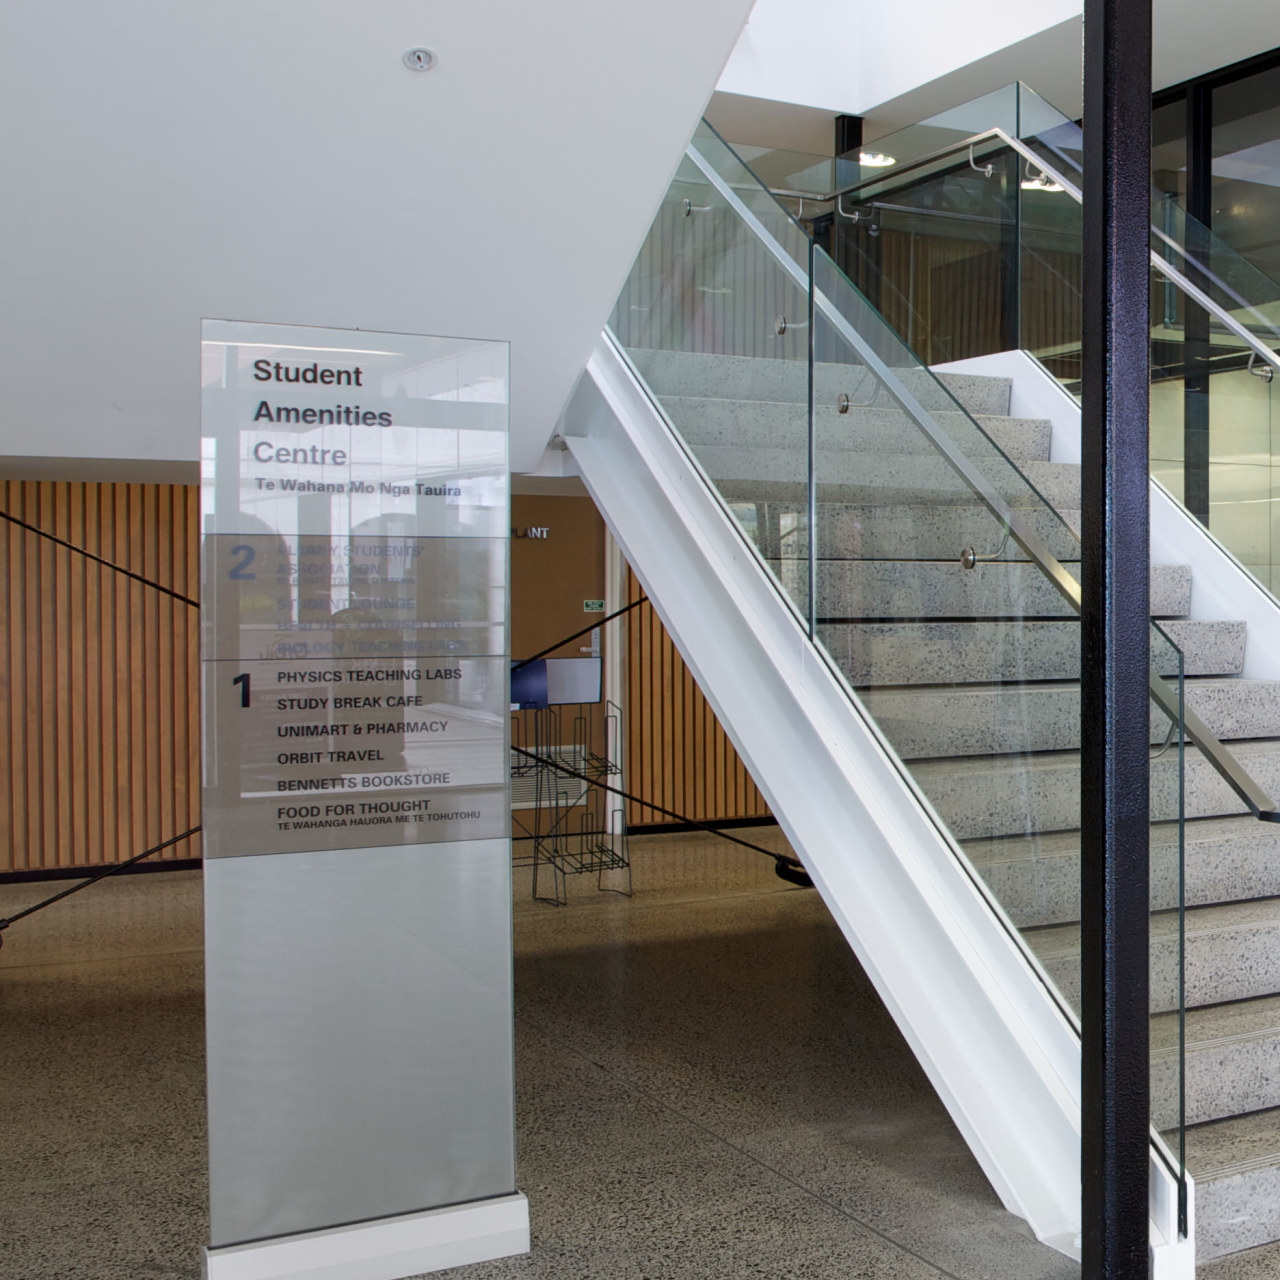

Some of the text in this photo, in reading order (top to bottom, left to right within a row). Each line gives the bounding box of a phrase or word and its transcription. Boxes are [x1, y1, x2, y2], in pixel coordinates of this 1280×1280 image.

[253, 359, 363, 387] Student
[253, 400, 393, 427] Amenities
[253, 441, 347, 466] Centre
[255, 478, 462, 497] Te Wahana Mo Nga Tauira
[229, 544, 256, 580] 2
[233, 672, 251, 708] 1
[277, 670, 342, 683] PHYSICS
[347, 669, 421, 681] TEACHING
[425, 669, 462, 680] LABS
[277, 696, 423, 710] STUDY BREAK CAFE
[277, 721, 448, 737] UNIMART & PHARMACY
[277, 750, 384, 765] ORBIT TRAVEL
[277, 773, 450, 792] BENNETTS BOOKSTORE
[277, 800, 431, 819] FOOD FOR THOUGHT
[277, 811, 481, 831] TE WAHANGA HAUORA ME TE TOHUTOHU
